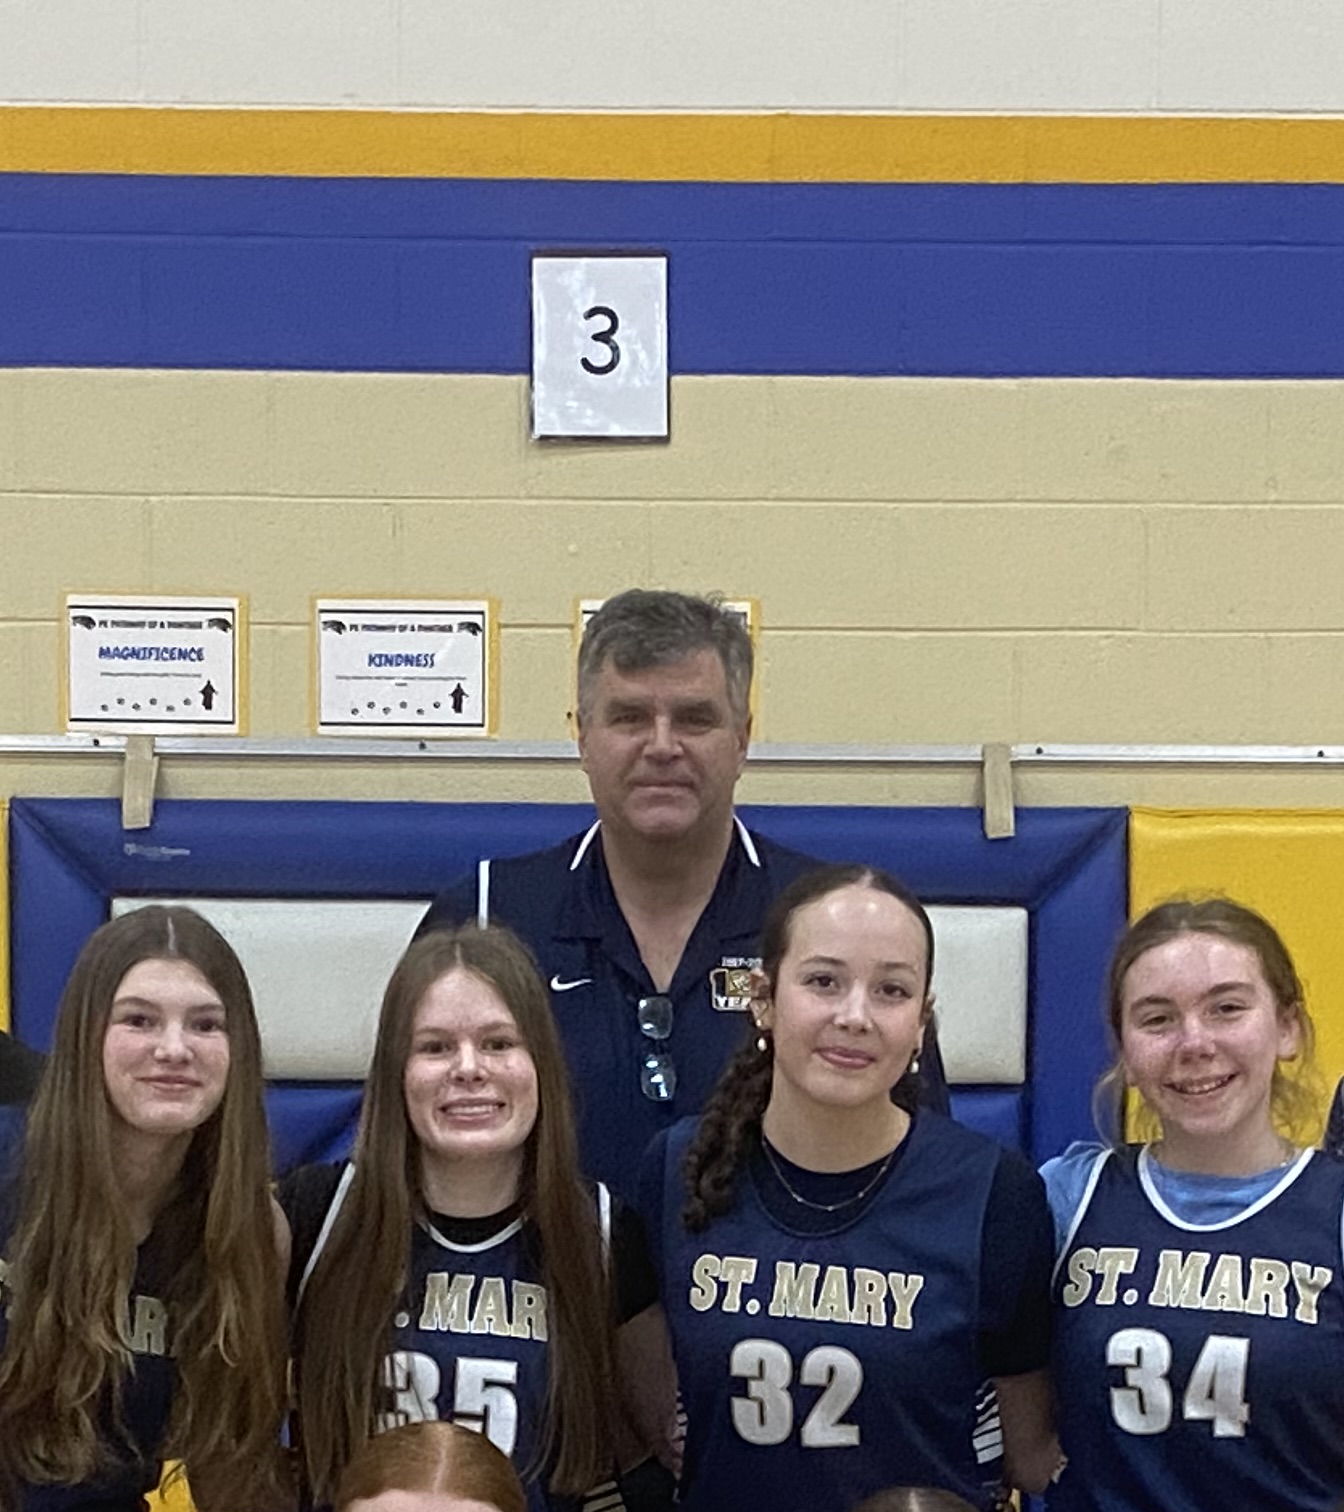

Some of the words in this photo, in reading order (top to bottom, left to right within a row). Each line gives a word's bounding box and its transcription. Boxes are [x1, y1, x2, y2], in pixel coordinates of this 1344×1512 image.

[580, 305, 621, 376] 3
[98, 646, 205, 661] MAGNIFICENCE
[367, 653, 436, 668] KINDNESS
[418, 1271, 549, 1343] MAR
[689, 1253, 761, 1315] ST.
[767, 1261, 924, 1330] MARY
[1062, 1246, 1140, 1307] ST.
[1148, 1249, 1333, 1325] MARY
[729, 1337, 864, 1448] 32
[1106, 1327, 1250, 1438] 34
